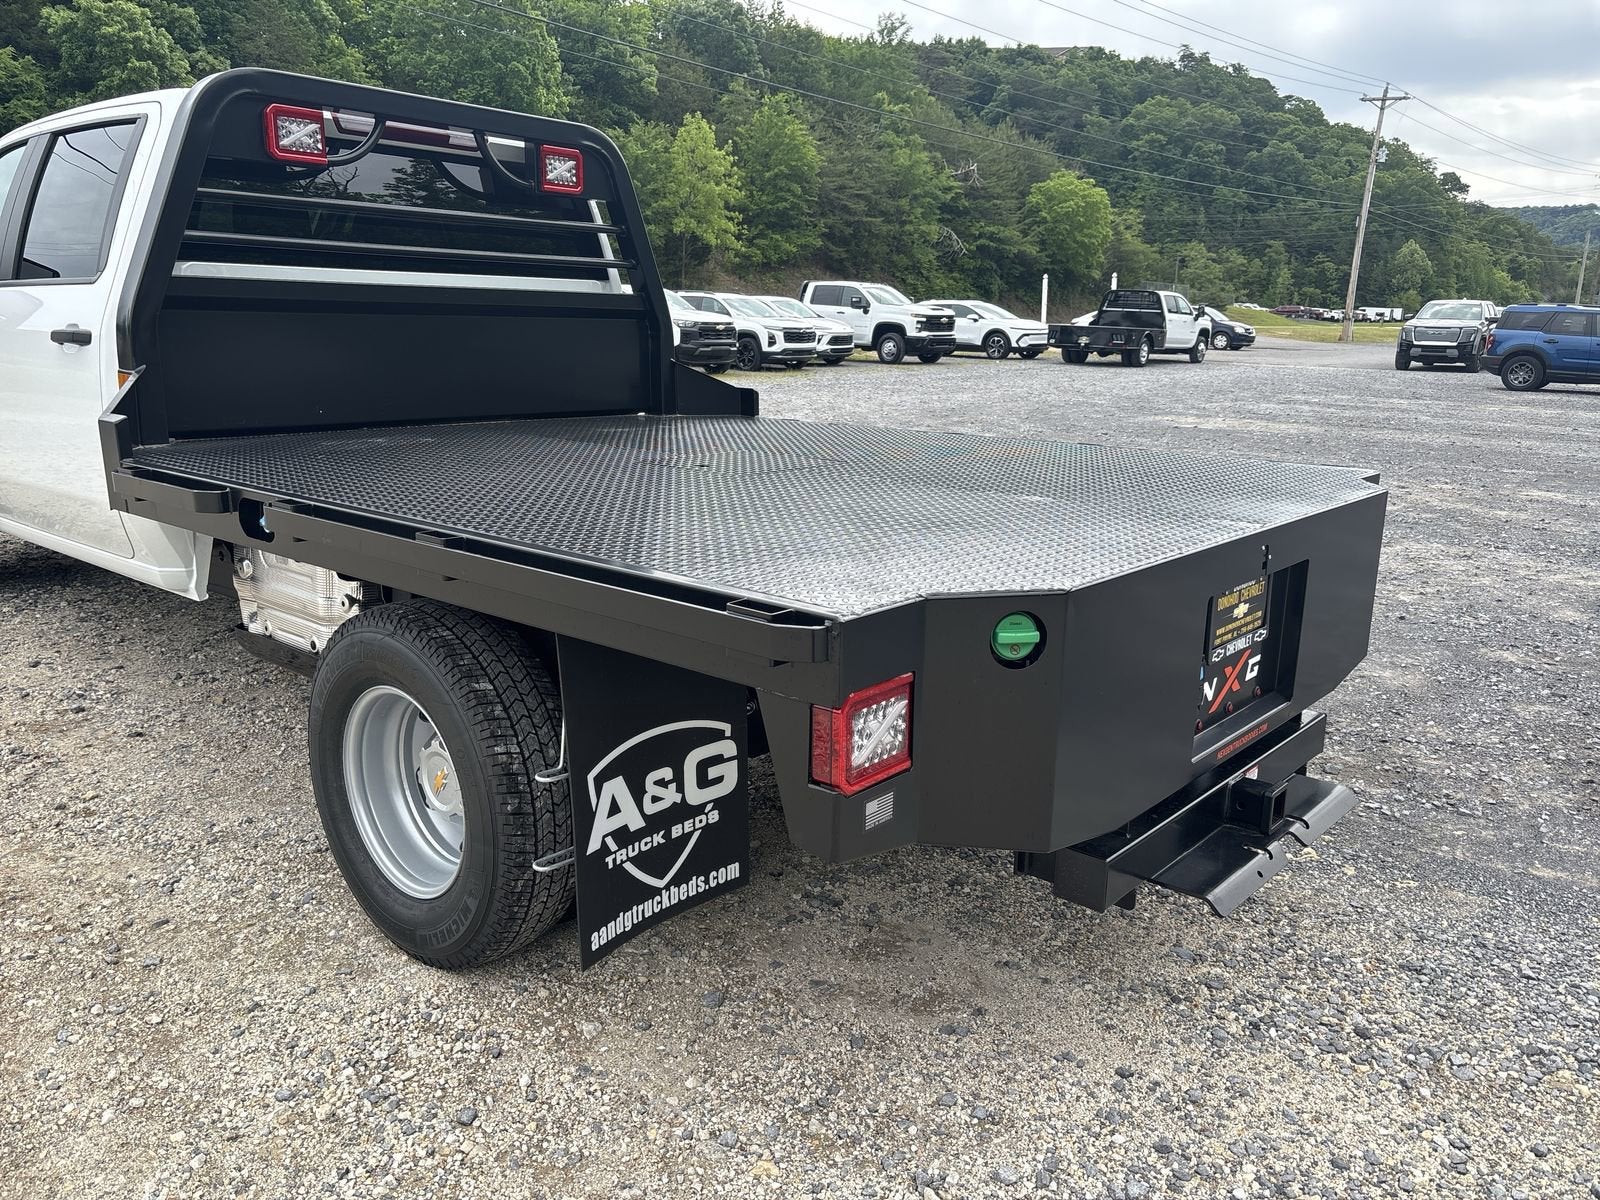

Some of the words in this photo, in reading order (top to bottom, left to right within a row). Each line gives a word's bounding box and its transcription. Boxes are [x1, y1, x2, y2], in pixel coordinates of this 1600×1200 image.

[1240, 581, 1265, 602] CHEVROLET
[1226, 633, 1253, 657] CHEVROLET
[586, 739, 738, 856] A&G
[605, 829, 666, 870] TRUCK
[590, 861, 741, 952] aandgtruckbeds.com
